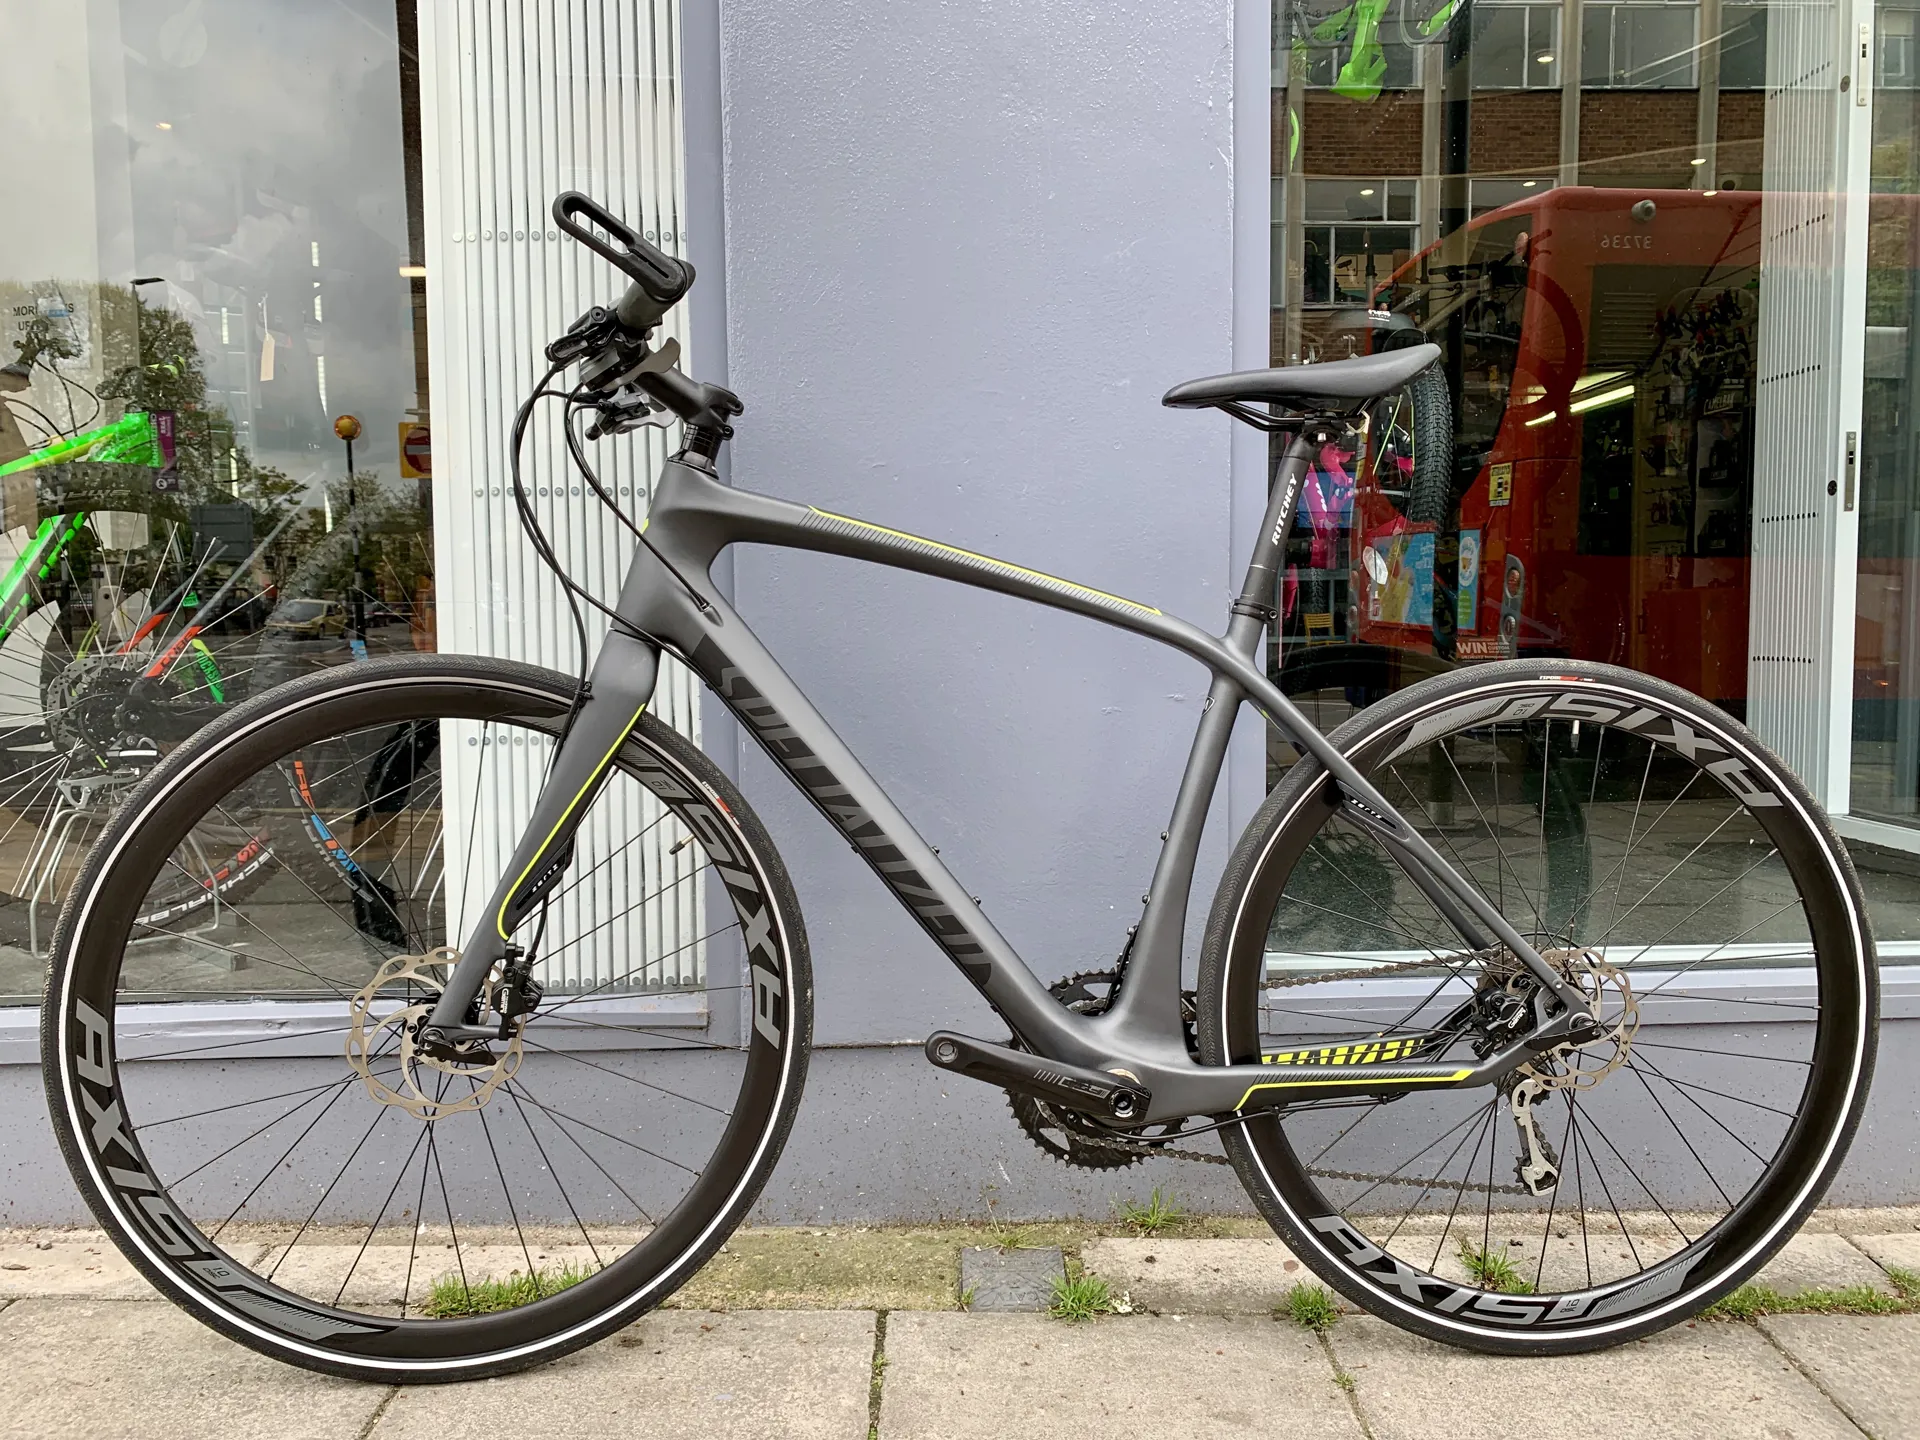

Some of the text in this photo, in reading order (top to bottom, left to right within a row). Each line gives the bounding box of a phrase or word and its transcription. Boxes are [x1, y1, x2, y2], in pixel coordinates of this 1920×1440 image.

[1271, 473, 1297, 546] RITCHEY
[1456, 641, 1488, 654] WIN
[1543, 691, 1783, 807] AXIS
[680, 802, 784, 1050] AXIS
[75, 998, 195, 1259] AXIS
[1309, 1216, 1546, 1325] AXIS
